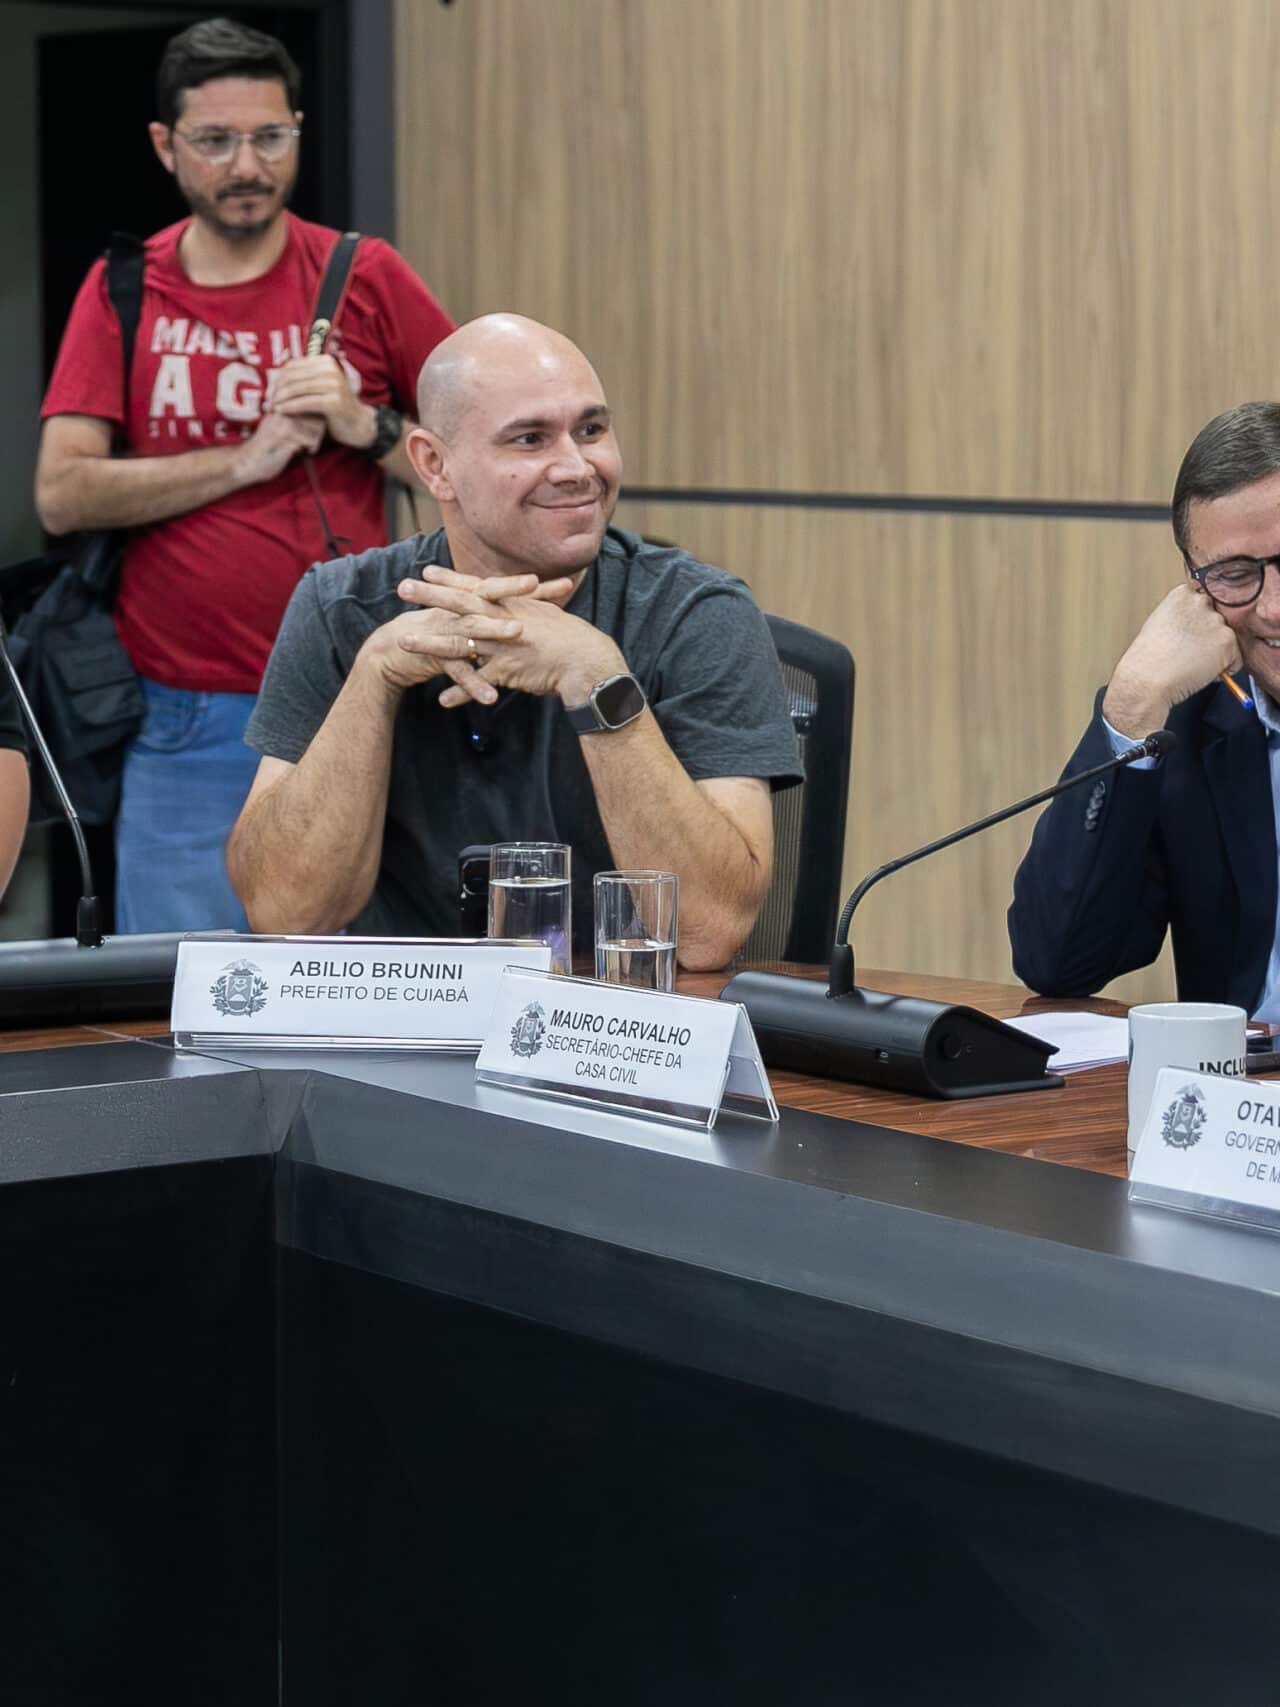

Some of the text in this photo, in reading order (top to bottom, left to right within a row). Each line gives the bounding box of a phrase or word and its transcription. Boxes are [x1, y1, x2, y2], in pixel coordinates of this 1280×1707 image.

[149, 355, 195, 418] A
[290, 961, 462, 979] ABILIO BRUNINI
[280, 985, 468, 1002] PREFEITO DE CUIABÁ
[550, 1009, 691, 1046] MAURO CARVALHO
[546, 1036, 681, 1069] SECRETÁRIO-CHEFE DA
[576, 1061, 637, 1085] CASA CIVIL
[1246, 1161, 1268, 1180] DE
